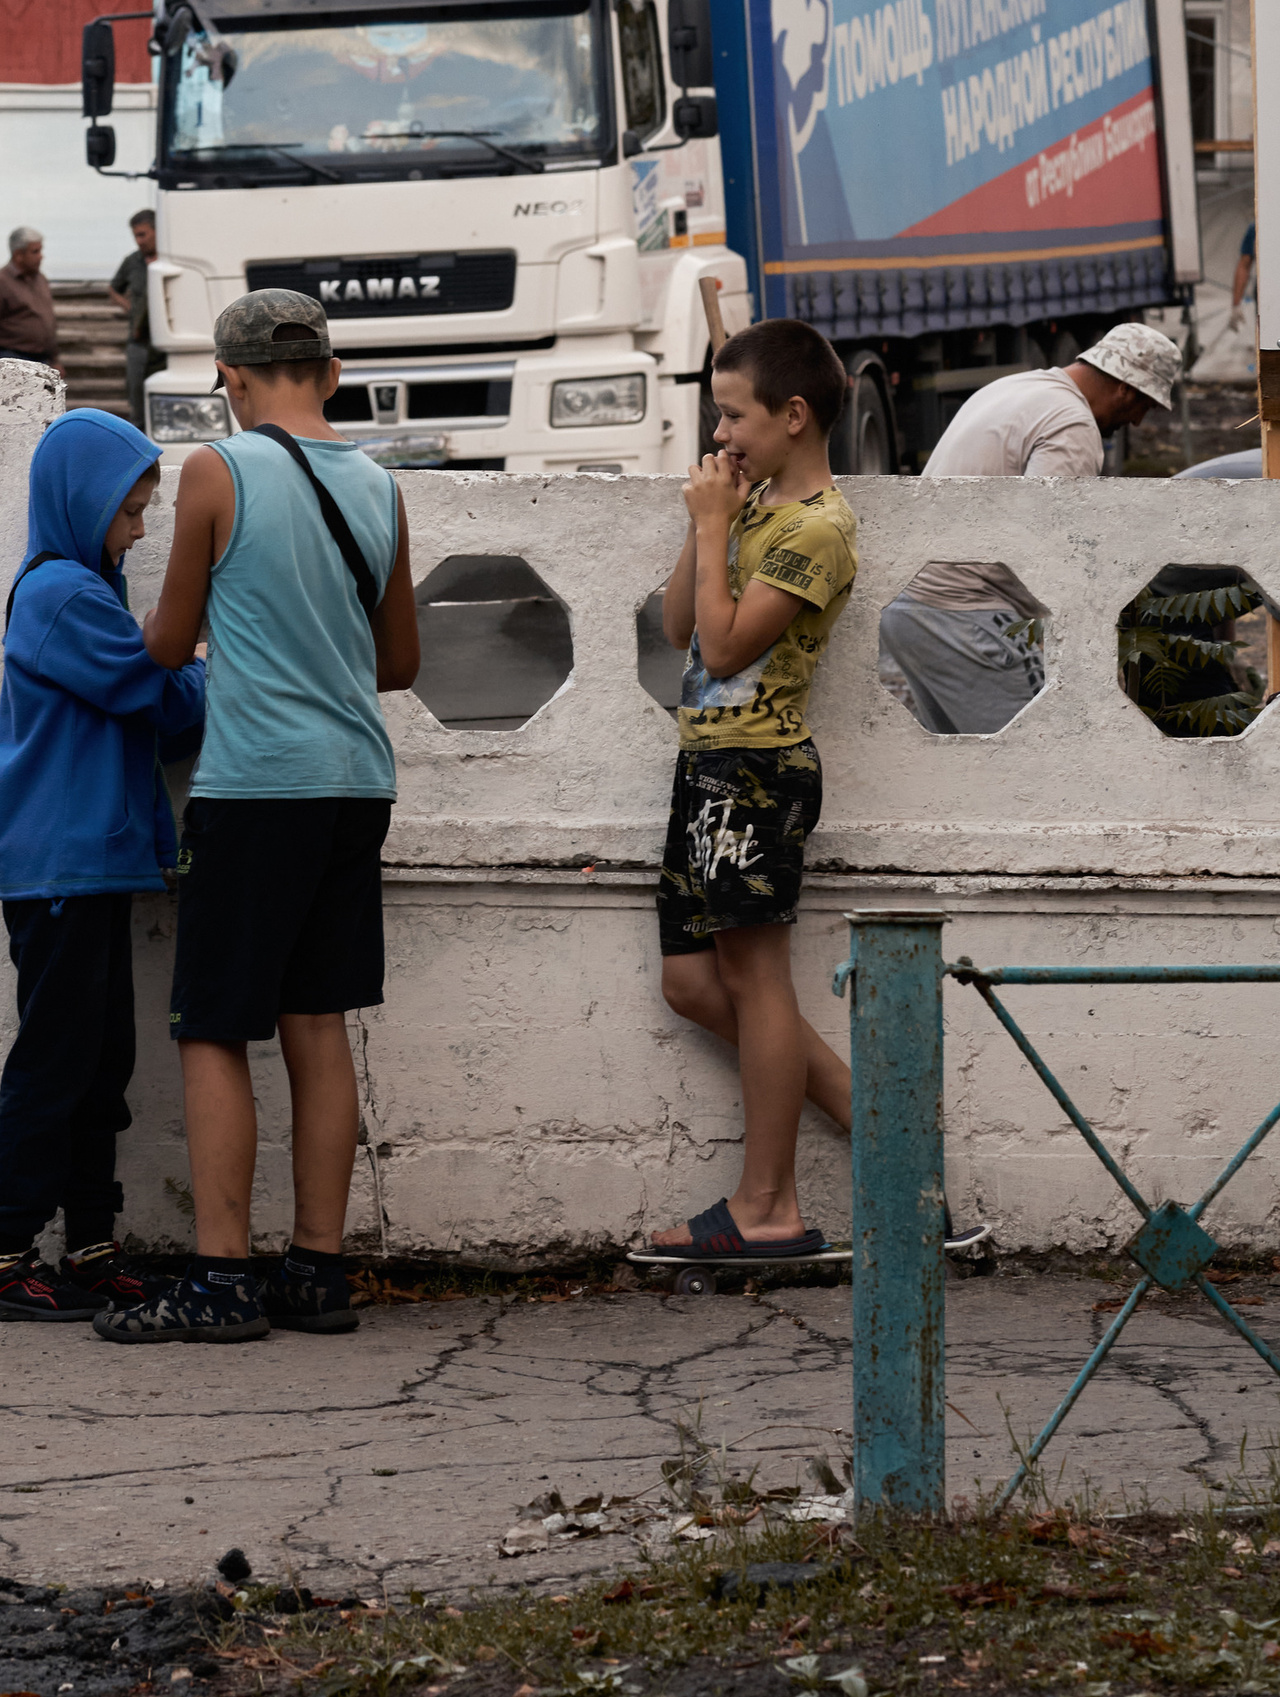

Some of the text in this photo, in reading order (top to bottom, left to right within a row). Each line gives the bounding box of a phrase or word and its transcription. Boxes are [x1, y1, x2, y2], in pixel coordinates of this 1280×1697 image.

[941, 22, 1050, 167] НАРОДНОЙ
[319, 276, 441, 303] KAMAZ
[779, 569, 812, 589] TIME
